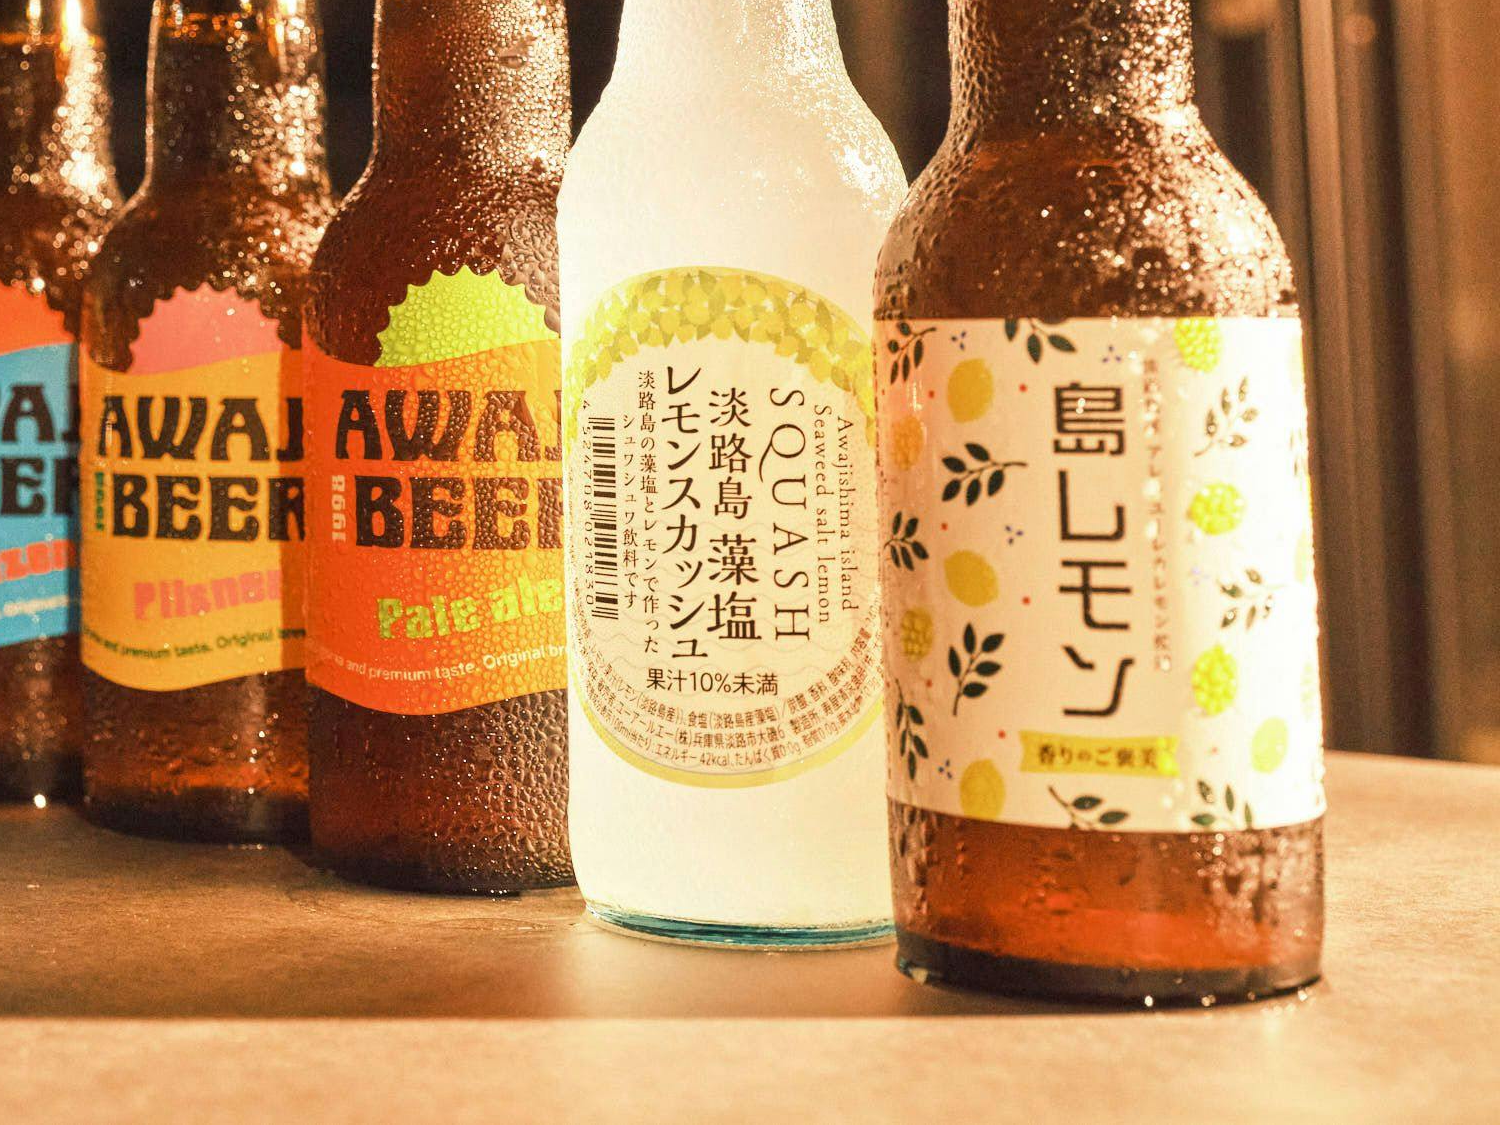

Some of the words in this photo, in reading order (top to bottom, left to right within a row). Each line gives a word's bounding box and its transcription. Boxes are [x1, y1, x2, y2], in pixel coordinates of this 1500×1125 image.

[814, 404, 835, 496] Seaweed
[831, 416, 856, 539] Awajishima
[112, 473, 305, 542] BEER
[331, 475, 347, 543] 1998
[622, 414, 639, 609] シュワシュワ飲料です
[638, 370, 659, 653] 淡路島の藻塩とレモンで作った
[661, 366, 708, 658] レモンスカッシュ
[758, 388, 810, 641] SQUASH
[816, 508, 836, 545] salt
[840, 549, 860, 611] island
[1052, 381, 1137, 718] 島レモン
[376, 594, 482, 640] Pale
[488, 571, 564, 624] ale
[817, 556, 836, 623] lemon
[368, 667, 433, 682] premium
[482, 644, 546, 670] Original
[646, 668, 778, 696] 果汁10%未満
